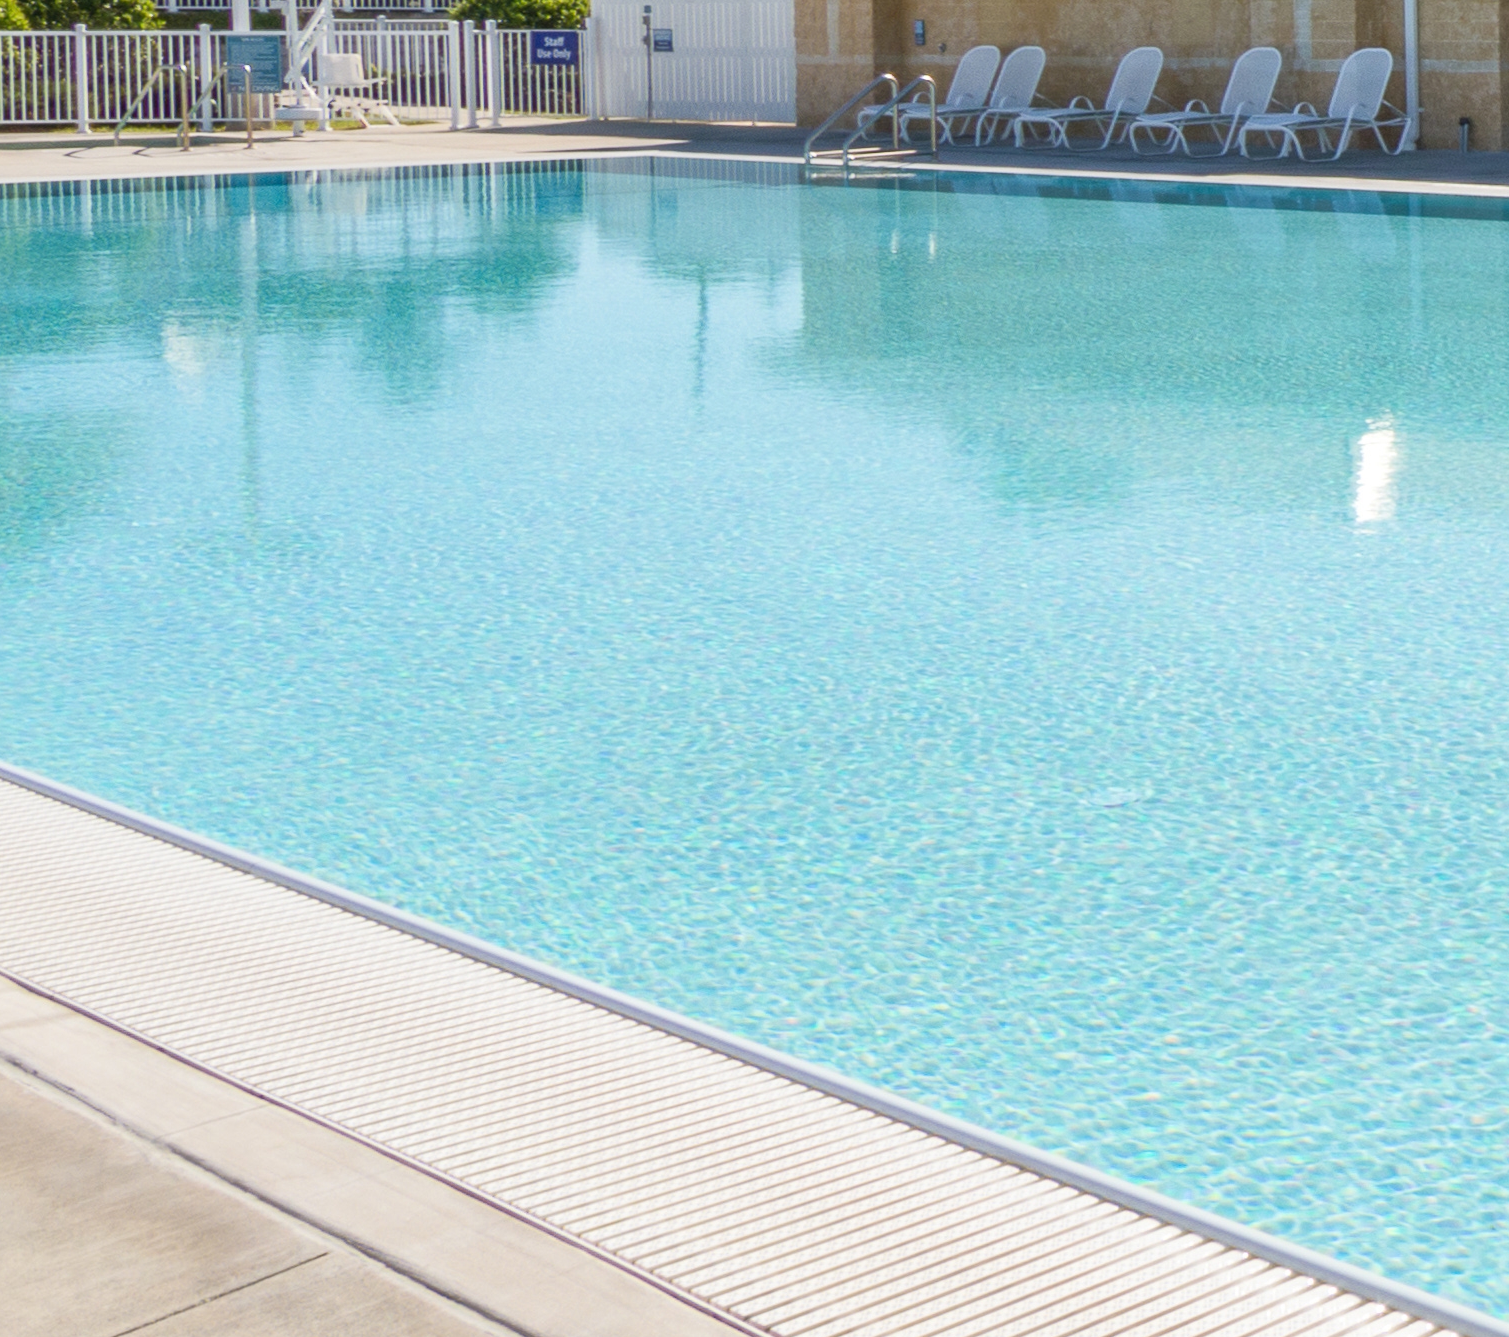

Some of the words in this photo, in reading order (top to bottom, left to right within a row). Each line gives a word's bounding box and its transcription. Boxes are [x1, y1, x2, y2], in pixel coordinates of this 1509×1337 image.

[544, 36, 565, 47] Staff
[536, 48, 551, 59] Use
[552, 48, 571, 61] Only
